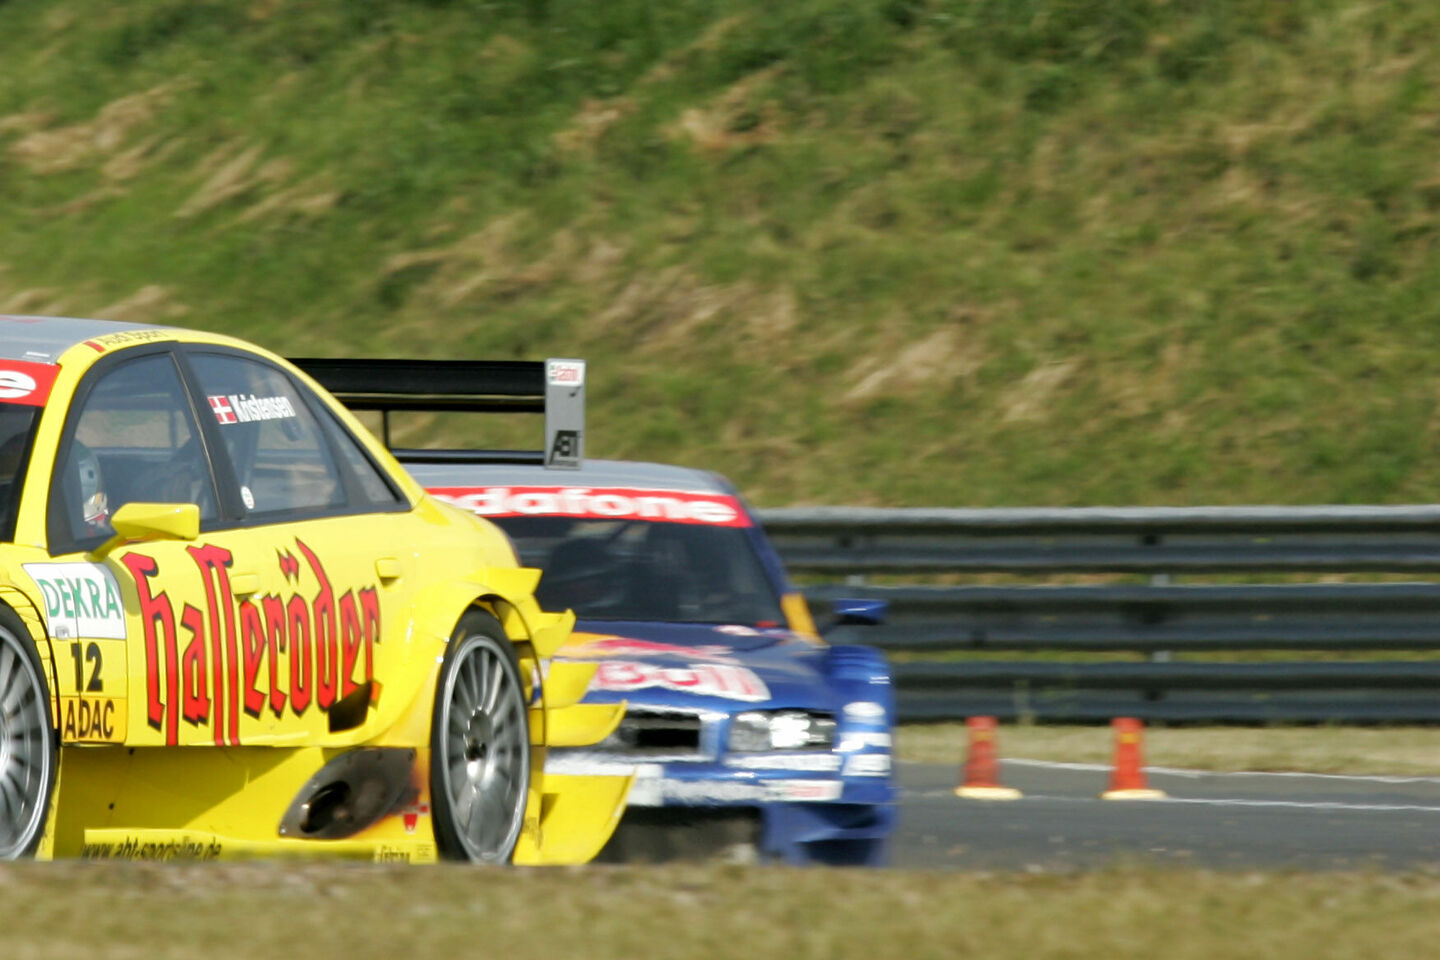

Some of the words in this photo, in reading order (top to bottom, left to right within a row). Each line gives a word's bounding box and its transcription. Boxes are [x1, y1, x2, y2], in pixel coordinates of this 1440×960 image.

[430, 487, 738, 523] dafone
[36, 576, 122, 620] DEKRA
[71, 641, 103, 692] 12
[63, 699, 115, 740] ADAC
